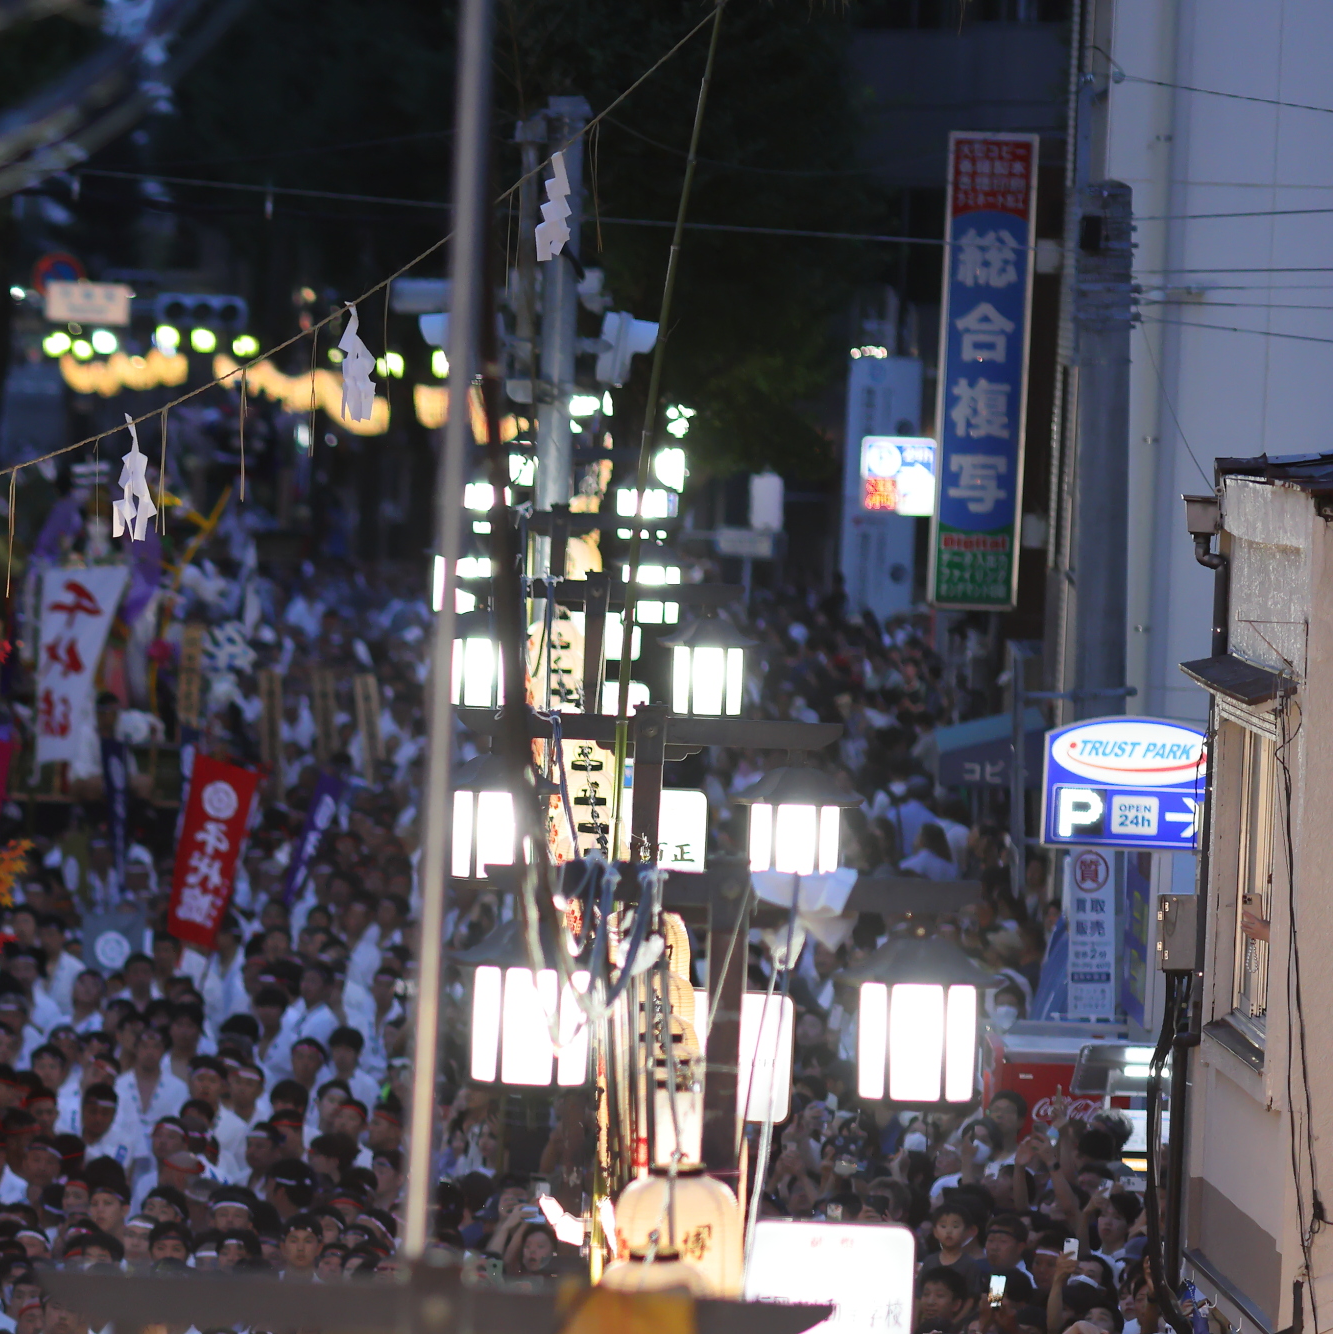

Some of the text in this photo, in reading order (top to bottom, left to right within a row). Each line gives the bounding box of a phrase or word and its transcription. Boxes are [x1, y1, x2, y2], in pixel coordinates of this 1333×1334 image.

[947, 227, 1019, 514] 総合複写
[1078, 740, 1196, 760] TRUST PARK
[1058, 787, 1103, 836] P
[1119, 803, 1152, 813] OPEN
[1118, 814, 1152, 828] 24h
[1079, 858, 1103, 885] 質
